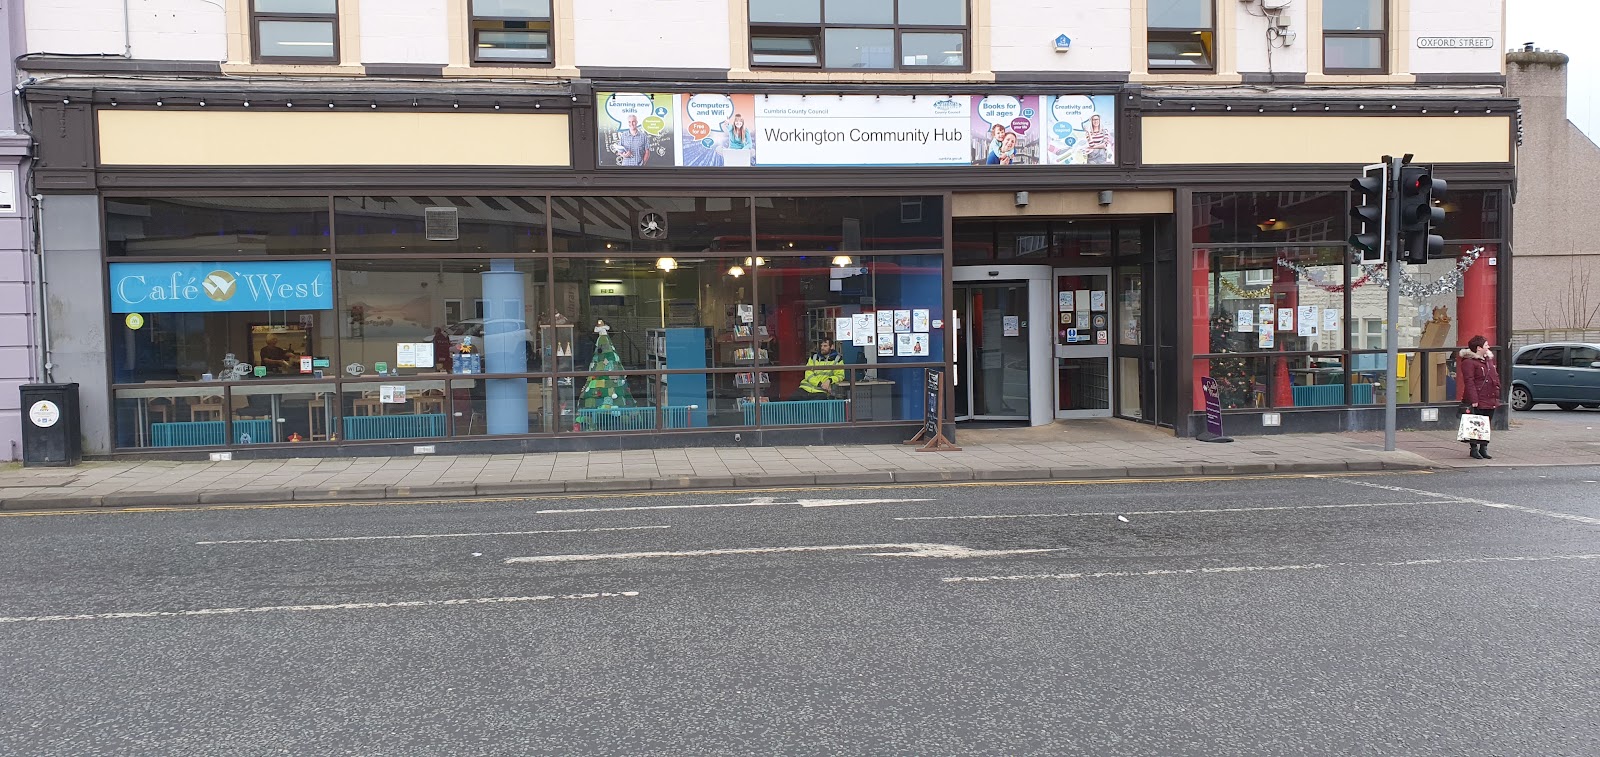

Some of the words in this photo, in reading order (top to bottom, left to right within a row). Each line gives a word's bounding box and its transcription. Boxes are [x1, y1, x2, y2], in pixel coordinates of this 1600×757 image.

[1420, 38, 1456, 46] OXFORD
[1459, 38, 1490, 46] STREET
[764, 128, 845, 145] Workington
[850, 128, 930, 145] Community
[934, 128, 962, 141] Hub
[117, 271, 199, 304] Café
[243, 273, 324, 302] West
